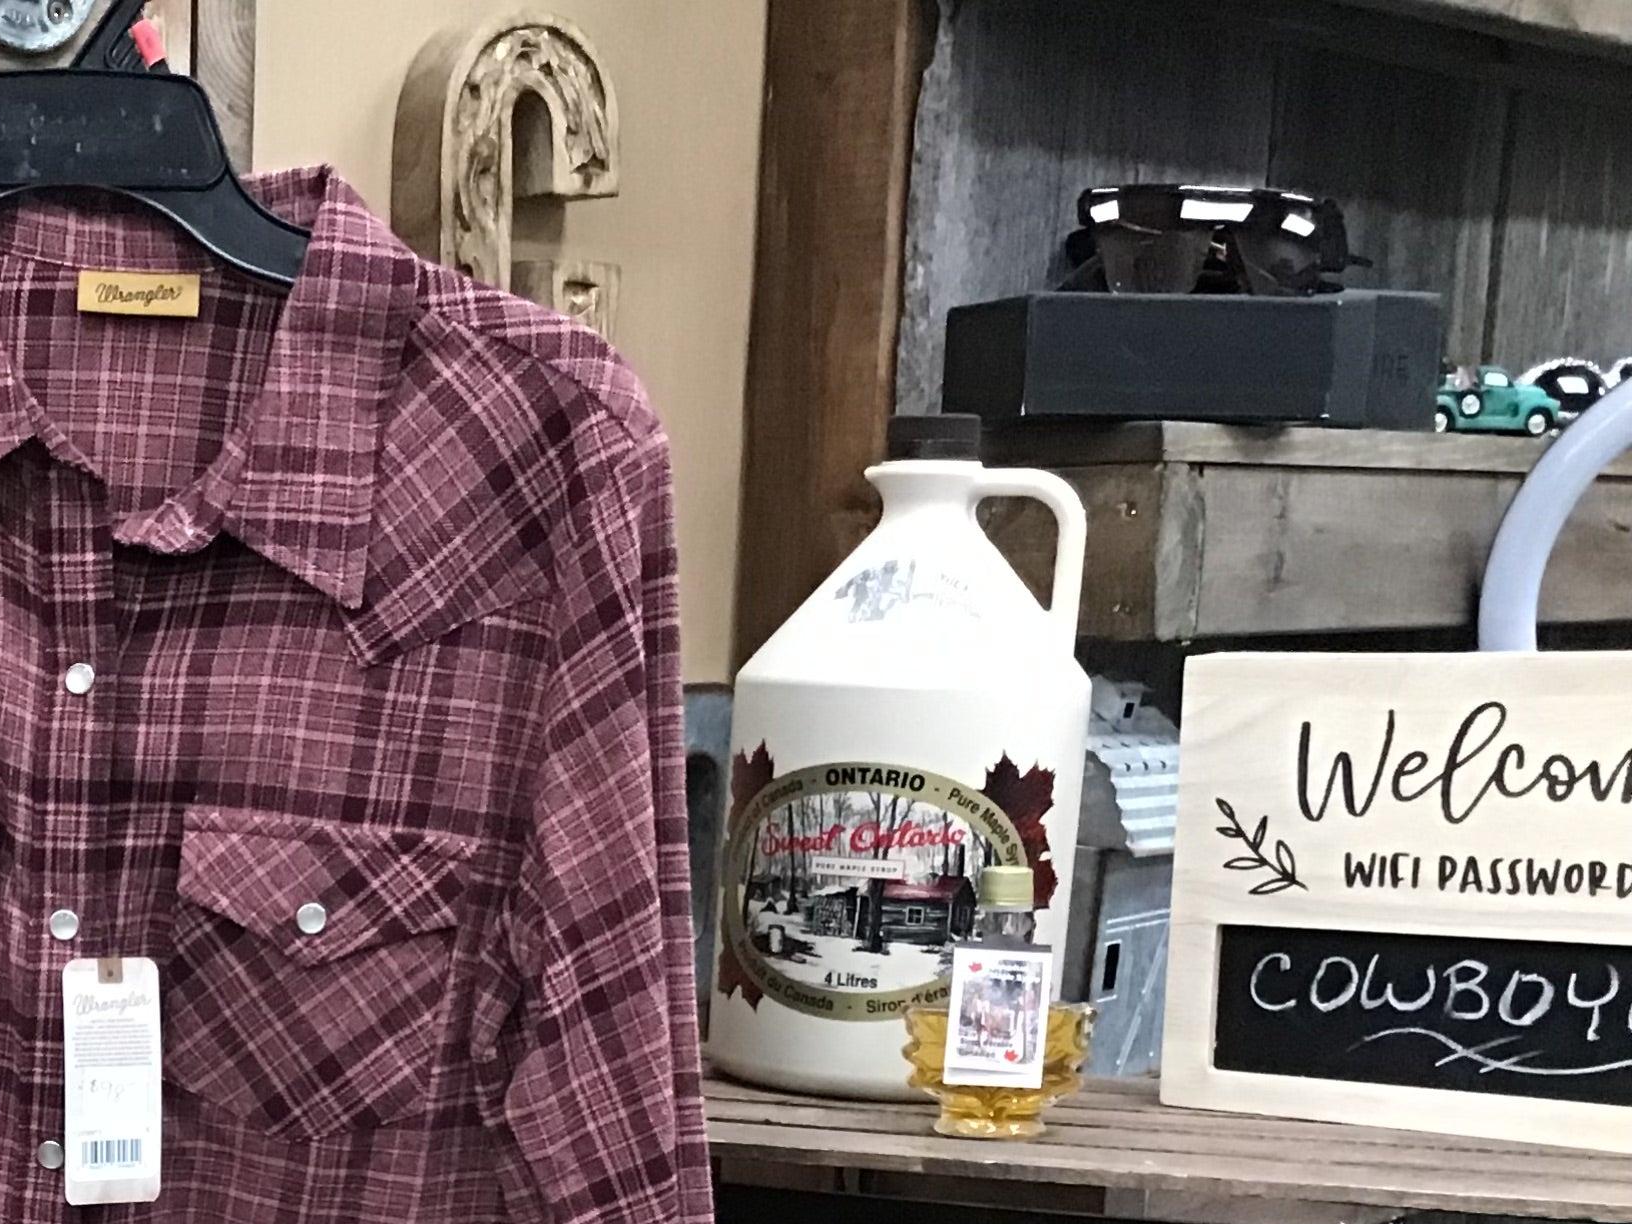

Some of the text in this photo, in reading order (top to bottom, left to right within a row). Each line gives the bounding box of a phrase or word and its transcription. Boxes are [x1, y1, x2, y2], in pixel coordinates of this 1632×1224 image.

[95, 282, 183, 307] Wrangler
[825, 767, 926, 792] ONTARIO
[947, 787, 980, 814] Pure
[979, 807, 1011, 845] Maple
[761, 822, 847, 856] Sweet
[850, 819, 966, 853] Ontario
[1344, 851, 1632, 899] WIFI PASSWORD
[824, 971, 878, 989] 4 Litres
[73, 990, 152, 1016] Wrangler
[783, 984, 834, 1011] Canada
[1250, 952, 1632, 1042] COWBOY
